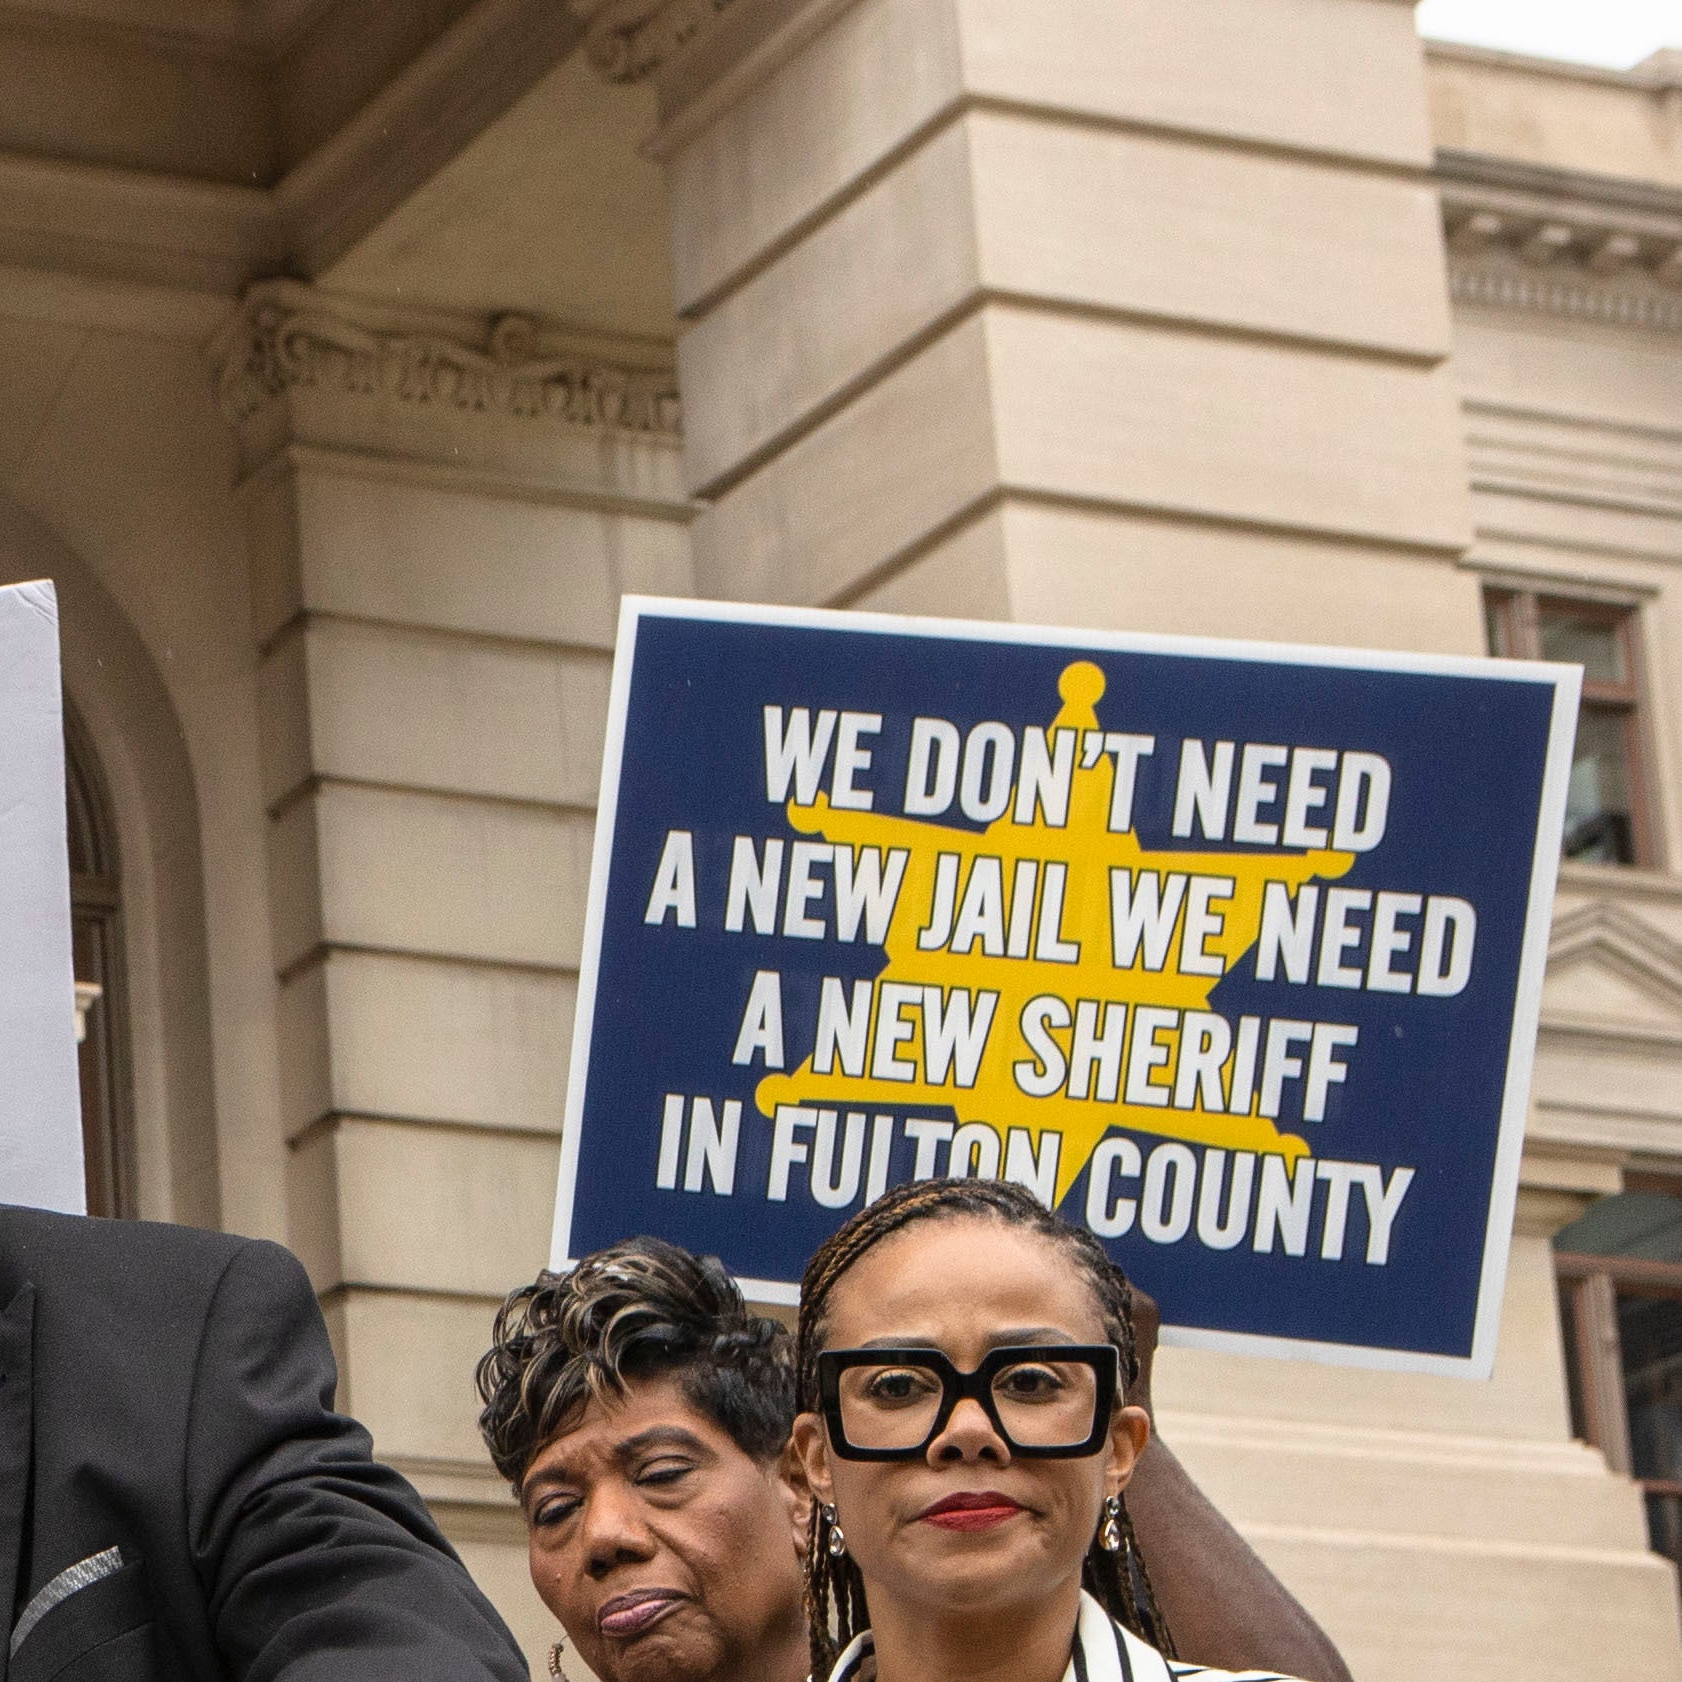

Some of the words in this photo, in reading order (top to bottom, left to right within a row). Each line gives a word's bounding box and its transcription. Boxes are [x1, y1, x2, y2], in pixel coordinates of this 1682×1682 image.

[765, 707, 881, 808] WE
[905, 719, 1154, 830] DON'T
[1174, 741, 1390, 850] NEED
[646, 832, 695, 926] A
[726, 838, 907, 942] NEW
[921, 856, 1077, 961] JAIL
[1113, 871, 1232, 974] WE
[1257, 884, 1475, 994] NEED
[734, 972, 783, 1066] A
[815, 979, 996, 1085] NEW
[1016, 998, 1357, 1120] SHERIFF
[658, 1096, 741, 1193] IN
[769, 1107, 1059, 1211] FULTON
[1087, 1139, 1413, 1263] COUNTY
